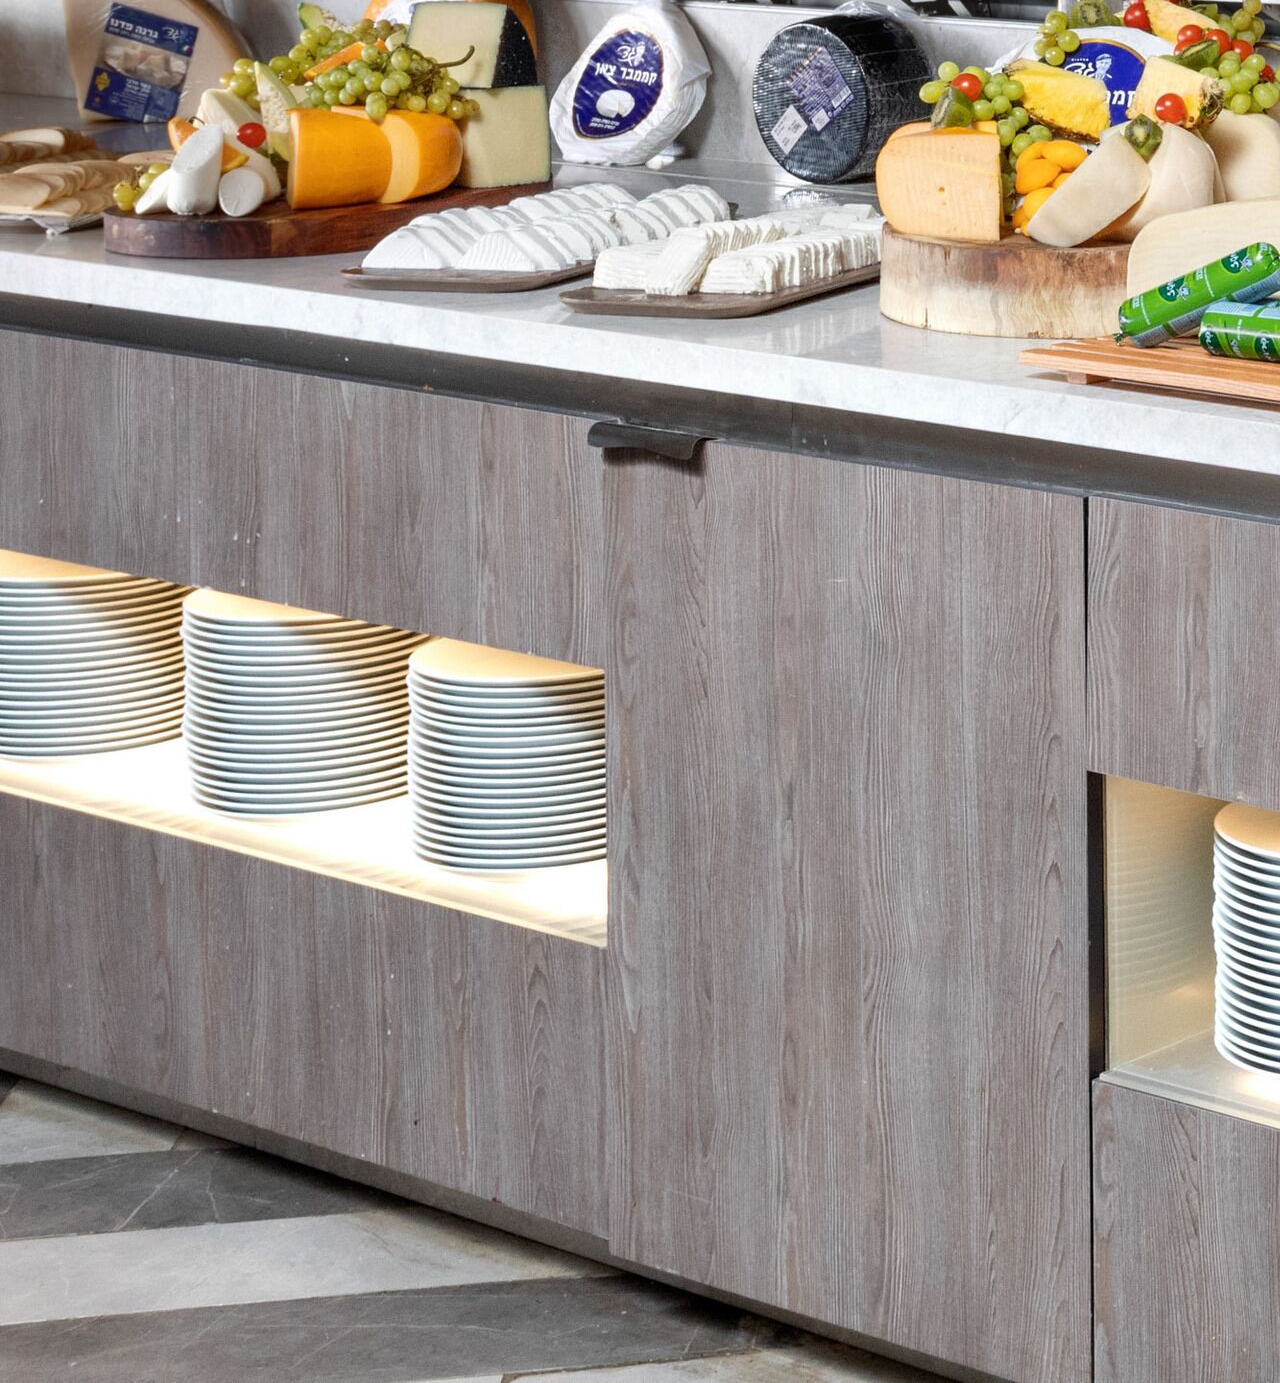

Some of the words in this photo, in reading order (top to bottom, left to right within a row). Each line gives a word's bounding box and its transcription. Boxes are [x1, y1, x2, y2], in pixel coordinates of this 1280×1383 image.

[109, 18, 135, 31] פדנו
[135, 25, 159, 39] גרנה
[595, 62, 617, 76] צאן
[620, 67, 658, 86] קממבר
